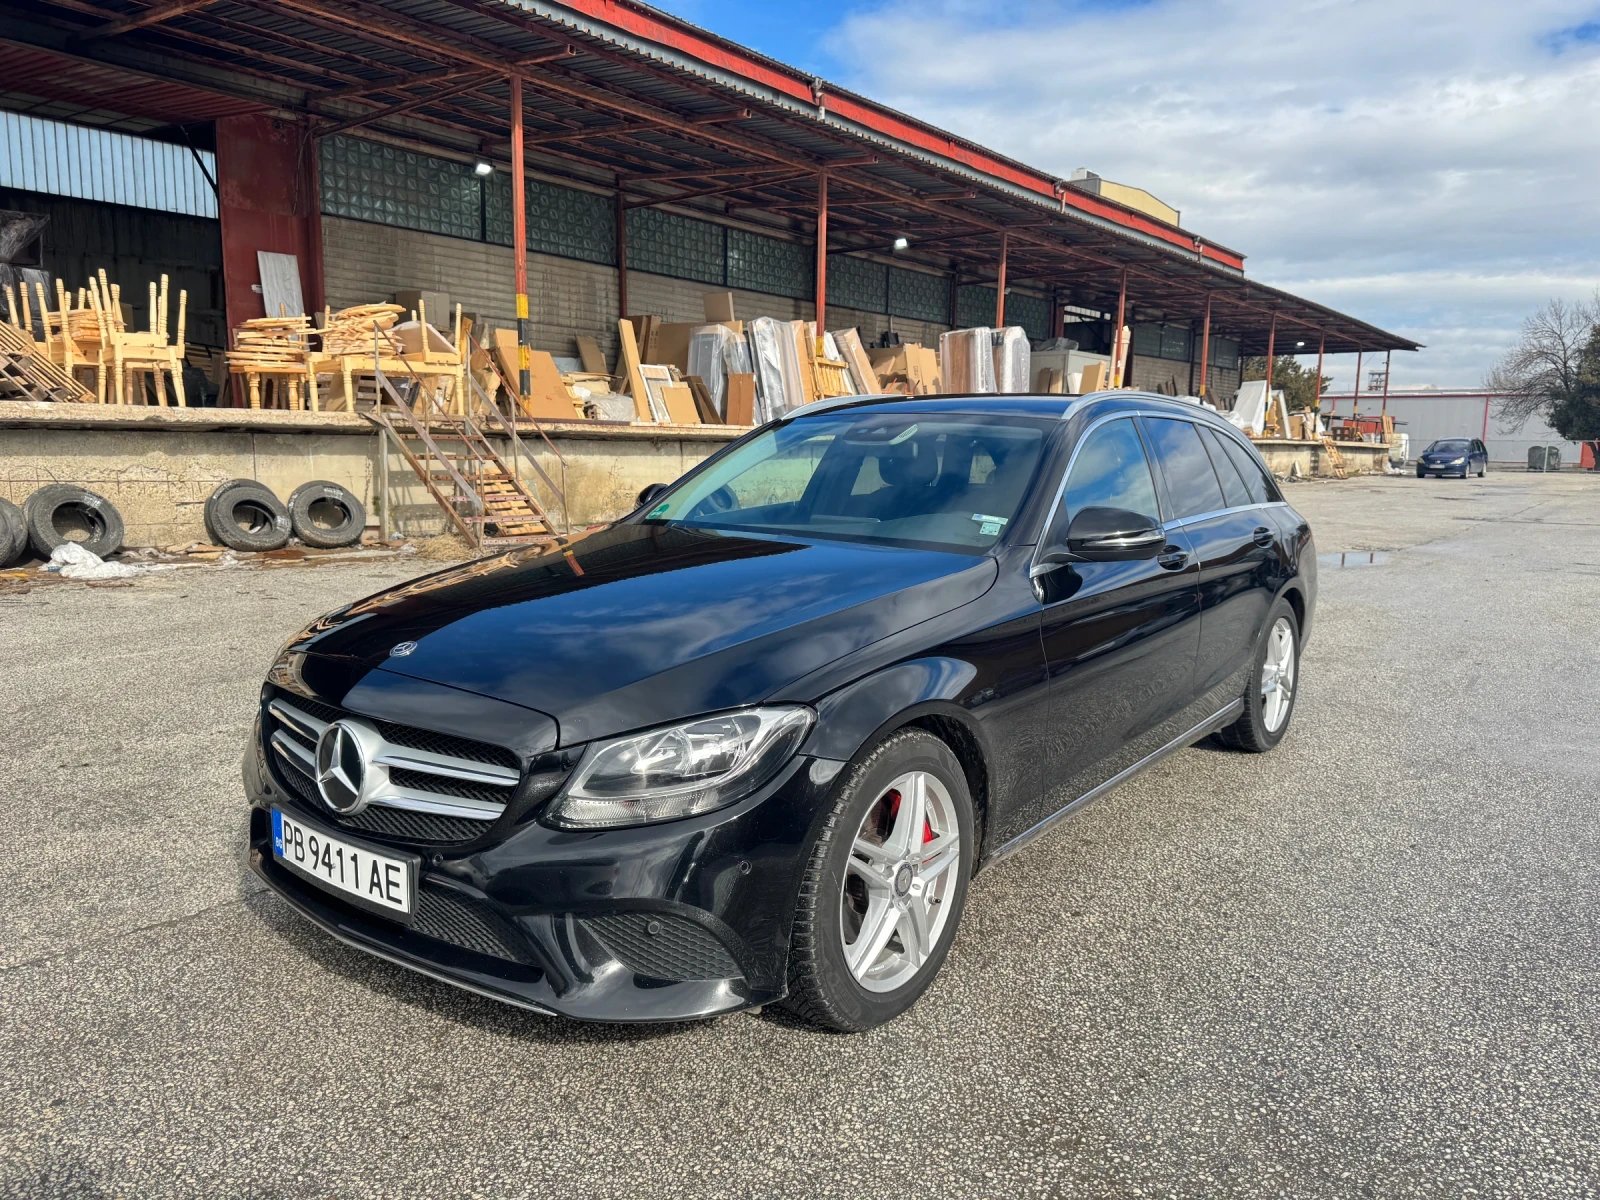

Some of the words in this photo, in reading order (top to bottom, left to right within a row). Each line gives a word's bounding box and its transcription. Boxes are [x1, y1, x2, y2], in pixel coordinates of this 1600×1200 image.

[275, 836, 283, 849] BG
[283, 819, 305, 863] PB
[308, 835, 360, 890] 9411
[368, 859, 403, 905] AE
